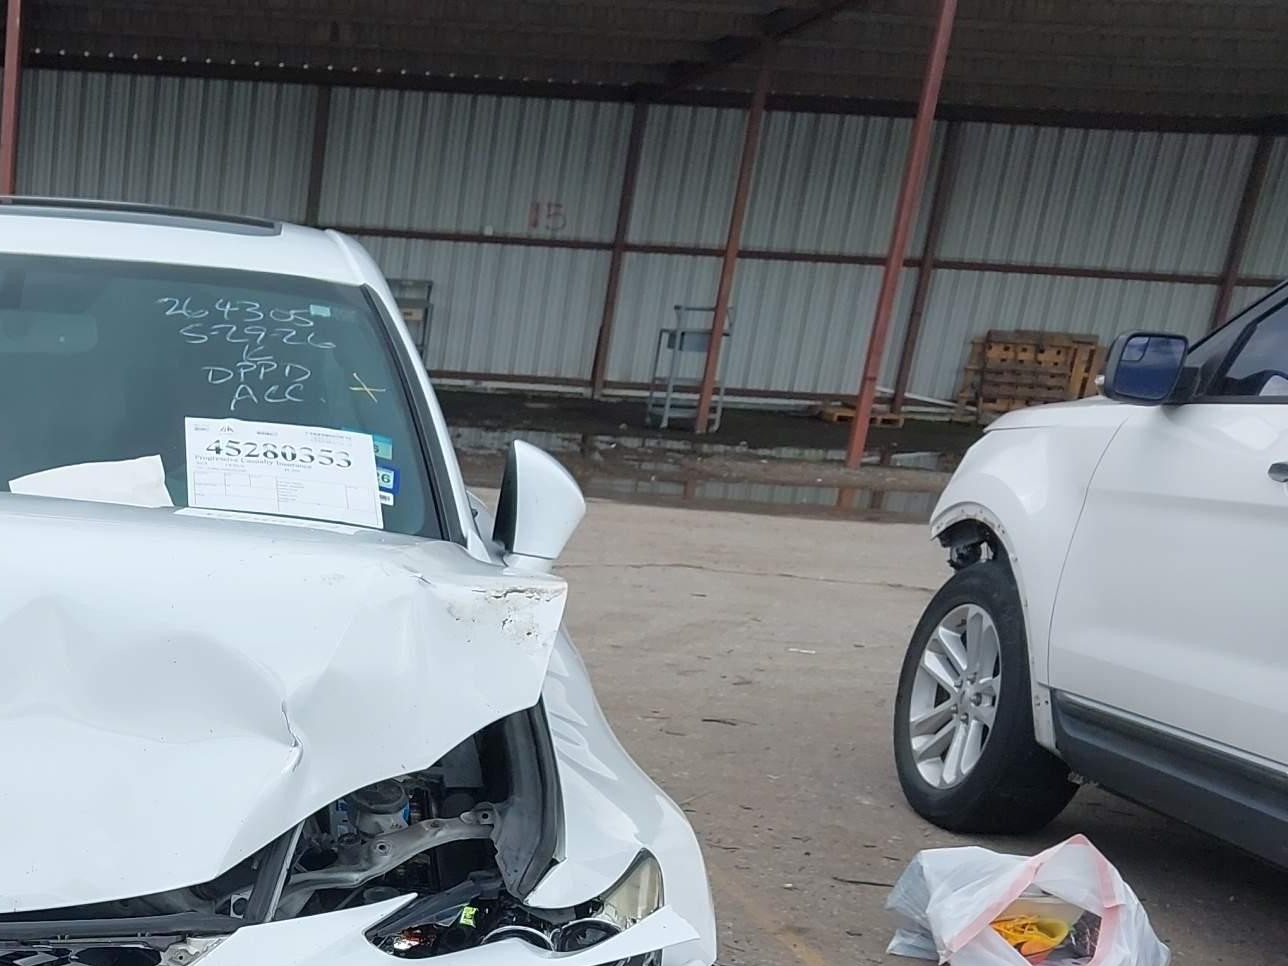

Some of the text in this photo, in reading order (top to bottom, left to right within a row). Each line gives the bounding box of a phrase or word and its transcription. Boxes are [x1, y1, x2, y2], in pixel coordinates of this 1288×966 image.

[529, 202, 567, 232] 15
[158, 297, 314, 326] 264305
[201, 361, 311, 384] DPPD
[230, 383, 305, 411] ACC
[194, 455, 238, 463] Progressive
[240, 457, 274, 466] Casualty
[276, 460, 313, 469] Insurance
[205, 439, 352, 468] 45280353
